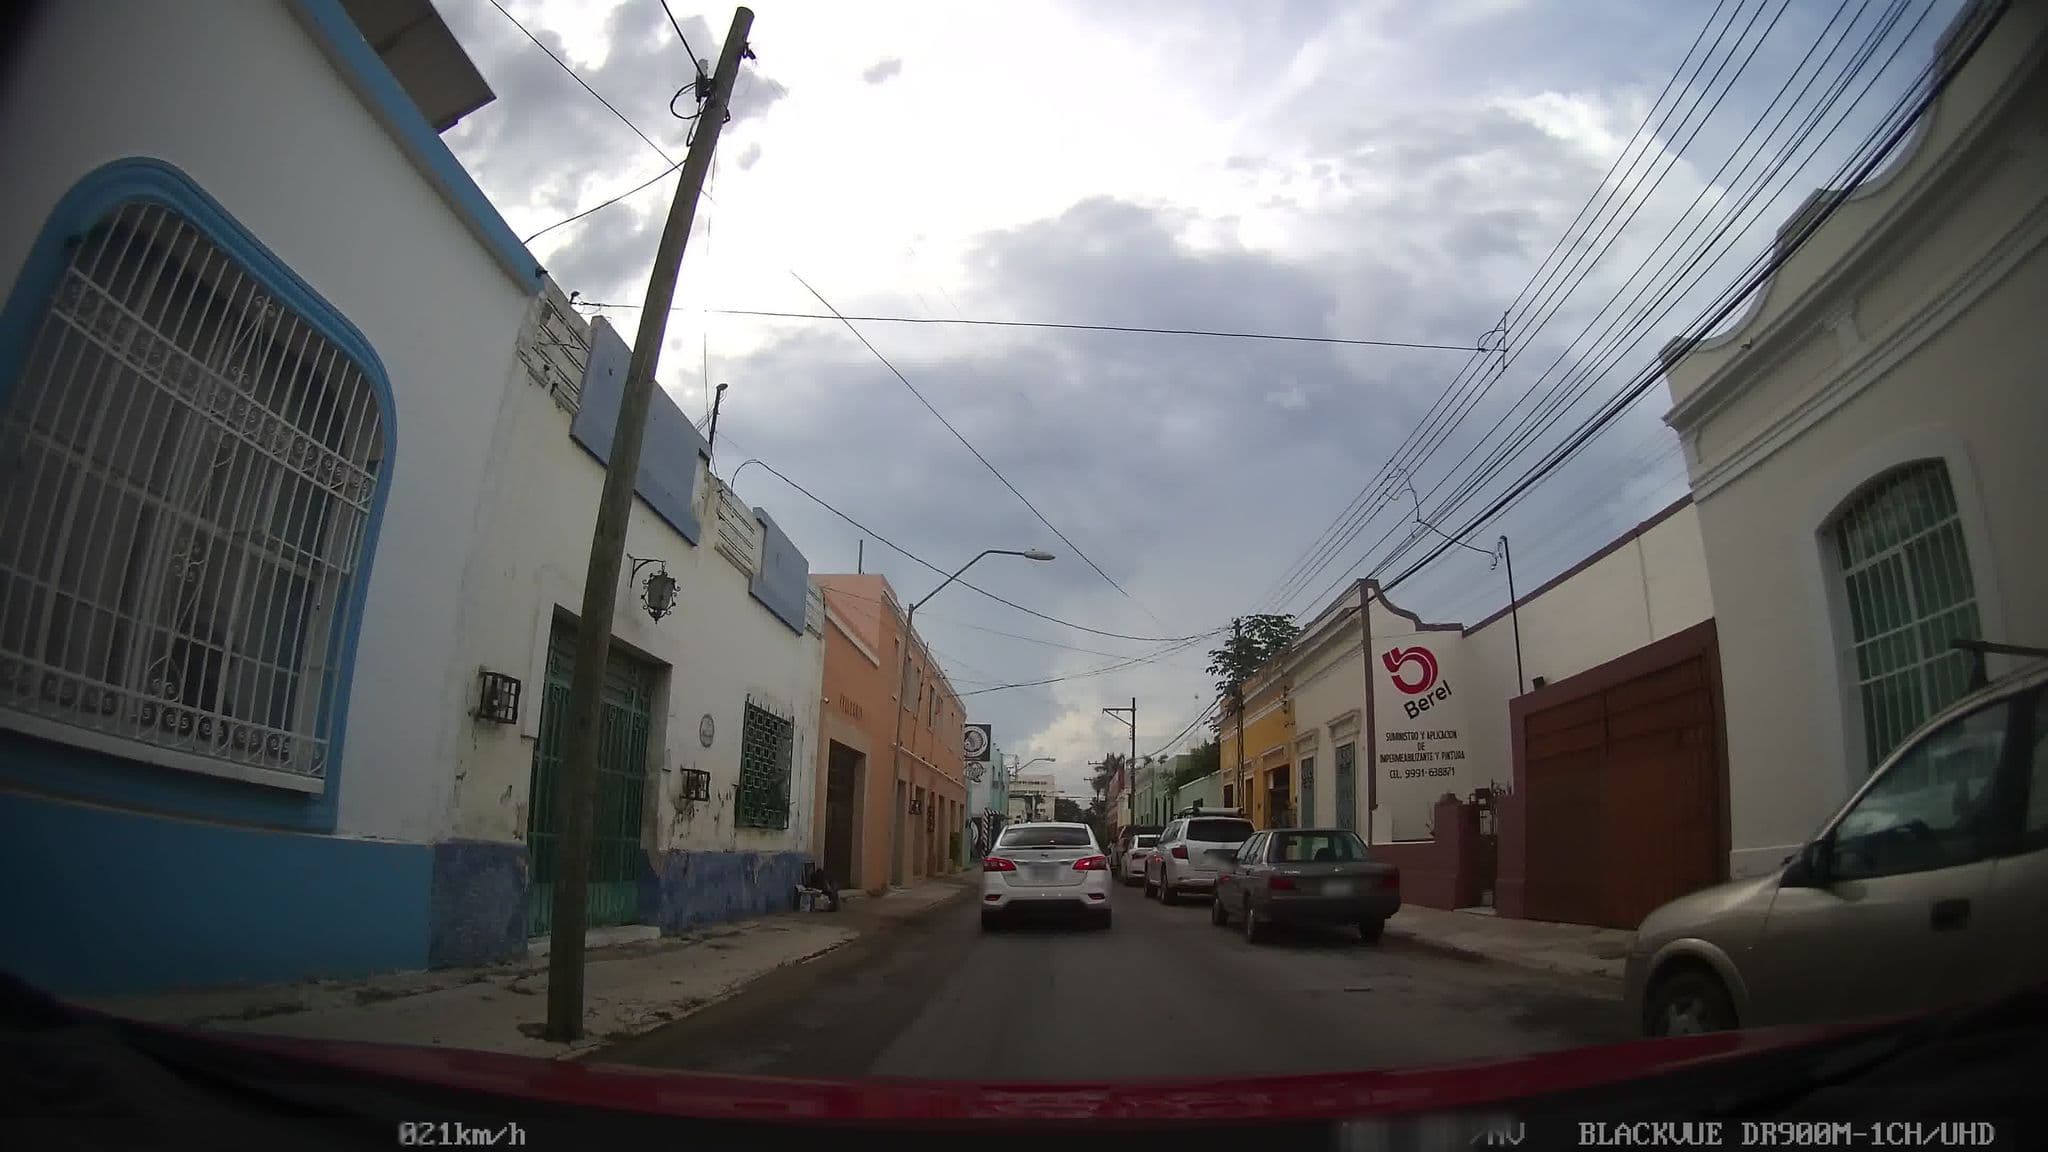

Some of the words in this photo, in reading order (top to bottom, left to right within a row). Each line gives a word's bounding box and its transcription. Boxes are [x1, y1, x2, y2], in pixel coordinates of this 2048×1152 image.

[1404, 679, 1452, 719] Berel
[1386, 731, 1418, 742] SUMINISTRO
[1420, 731, 1426, 740] Y
[1417, 742, 1425, 751] DE
[1380, 752, 1433, 763] IMPERMEABILIZANTE
[1434, 752, 1440, 760] Y
[1442, 750, 1465, 760] PINTURA
